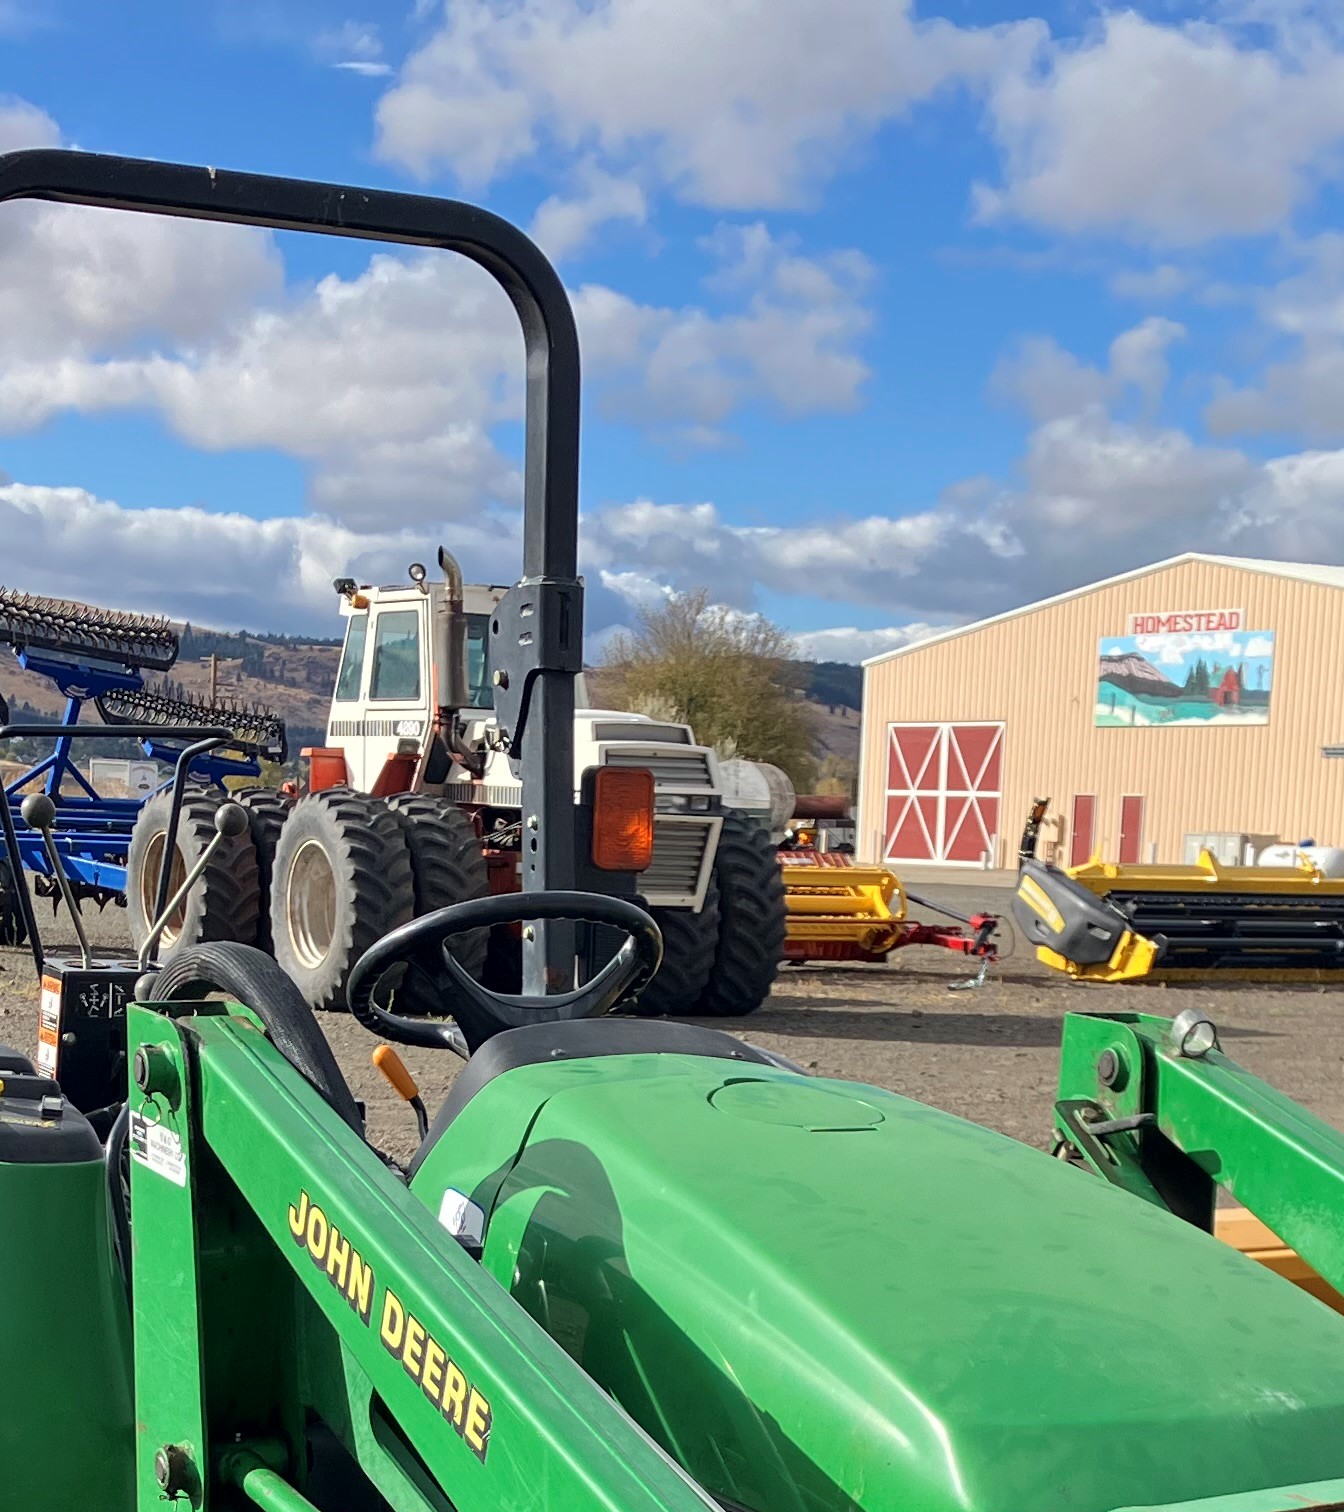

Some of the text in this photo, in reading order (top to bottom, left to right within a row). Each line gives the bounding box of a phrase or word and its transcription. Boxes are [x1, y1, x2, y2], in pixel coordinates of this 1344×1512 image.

[1133, 611, 1240, 635] HOMESTEAD
[288, 1189, 493, 1463] JOHN DEERE
